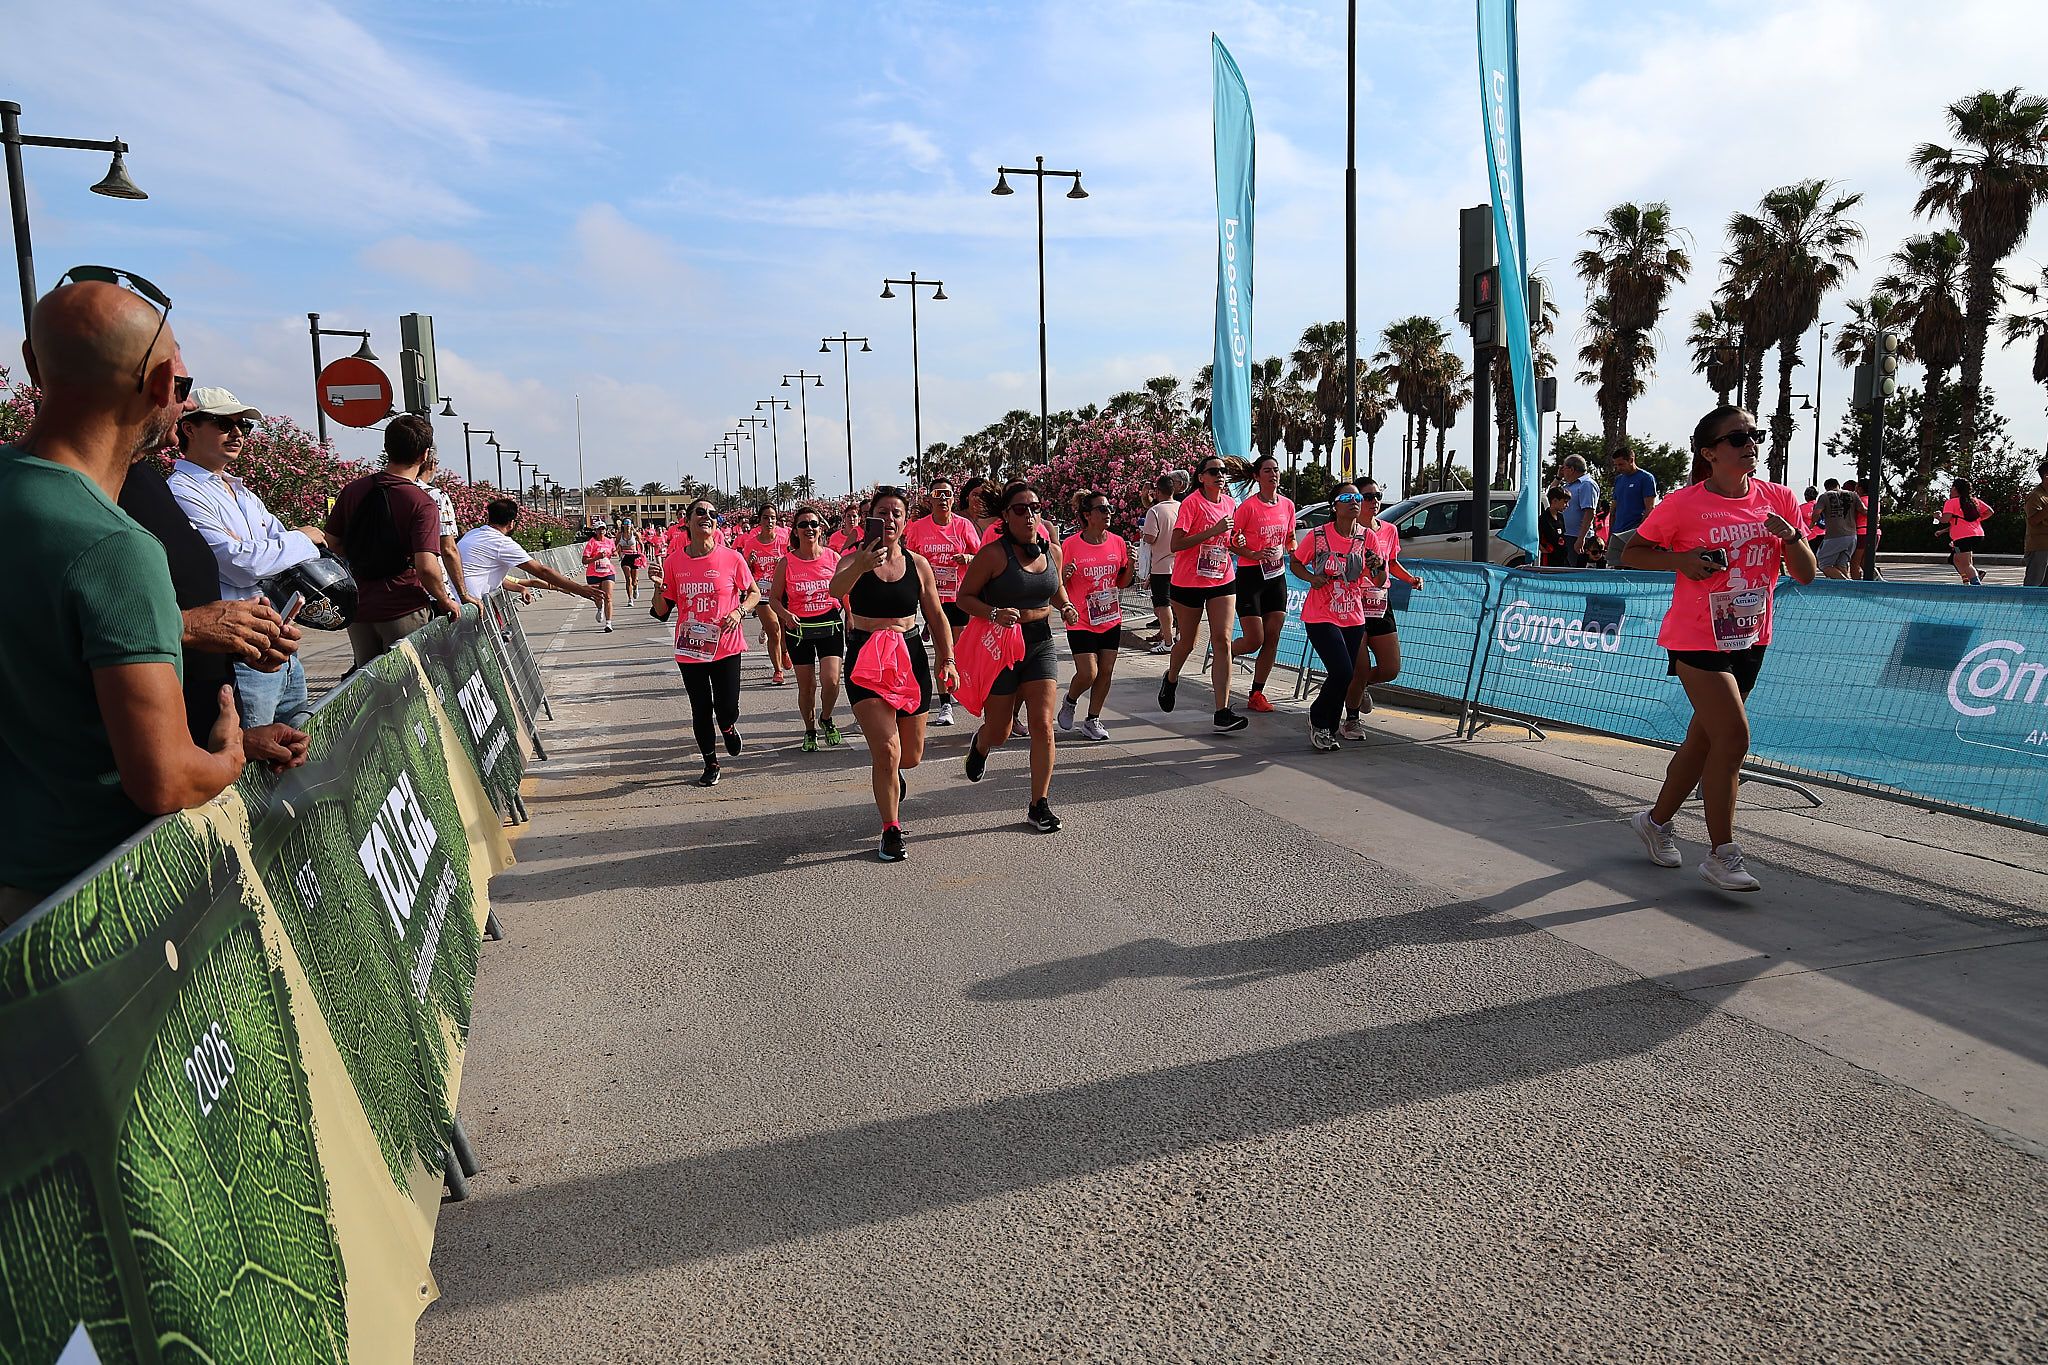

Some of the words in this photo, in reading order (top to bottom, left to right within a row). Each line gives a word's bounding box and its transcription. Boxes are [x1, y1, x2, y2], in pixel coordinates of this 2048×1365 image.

[1701, 511, 1731, 520] OYSHO
[1709, 522, 1773, 544] CARRER
[923, 544, 955, 553] CARRERA
[1745, 544, 1767, 567] DE
[938, 553, 950, 565] DE
[1083, 564, 1117, 577] CARRERA
[696, 597, 710, 613] DE
[1499, 600, 1626, 652] Compeed
[1736, 616, 1758, 627] 016
[689, 638, 705, 647] 016
[295, 859, 322, 913] 1975
[185, 1020, 235, 1118] 2026
